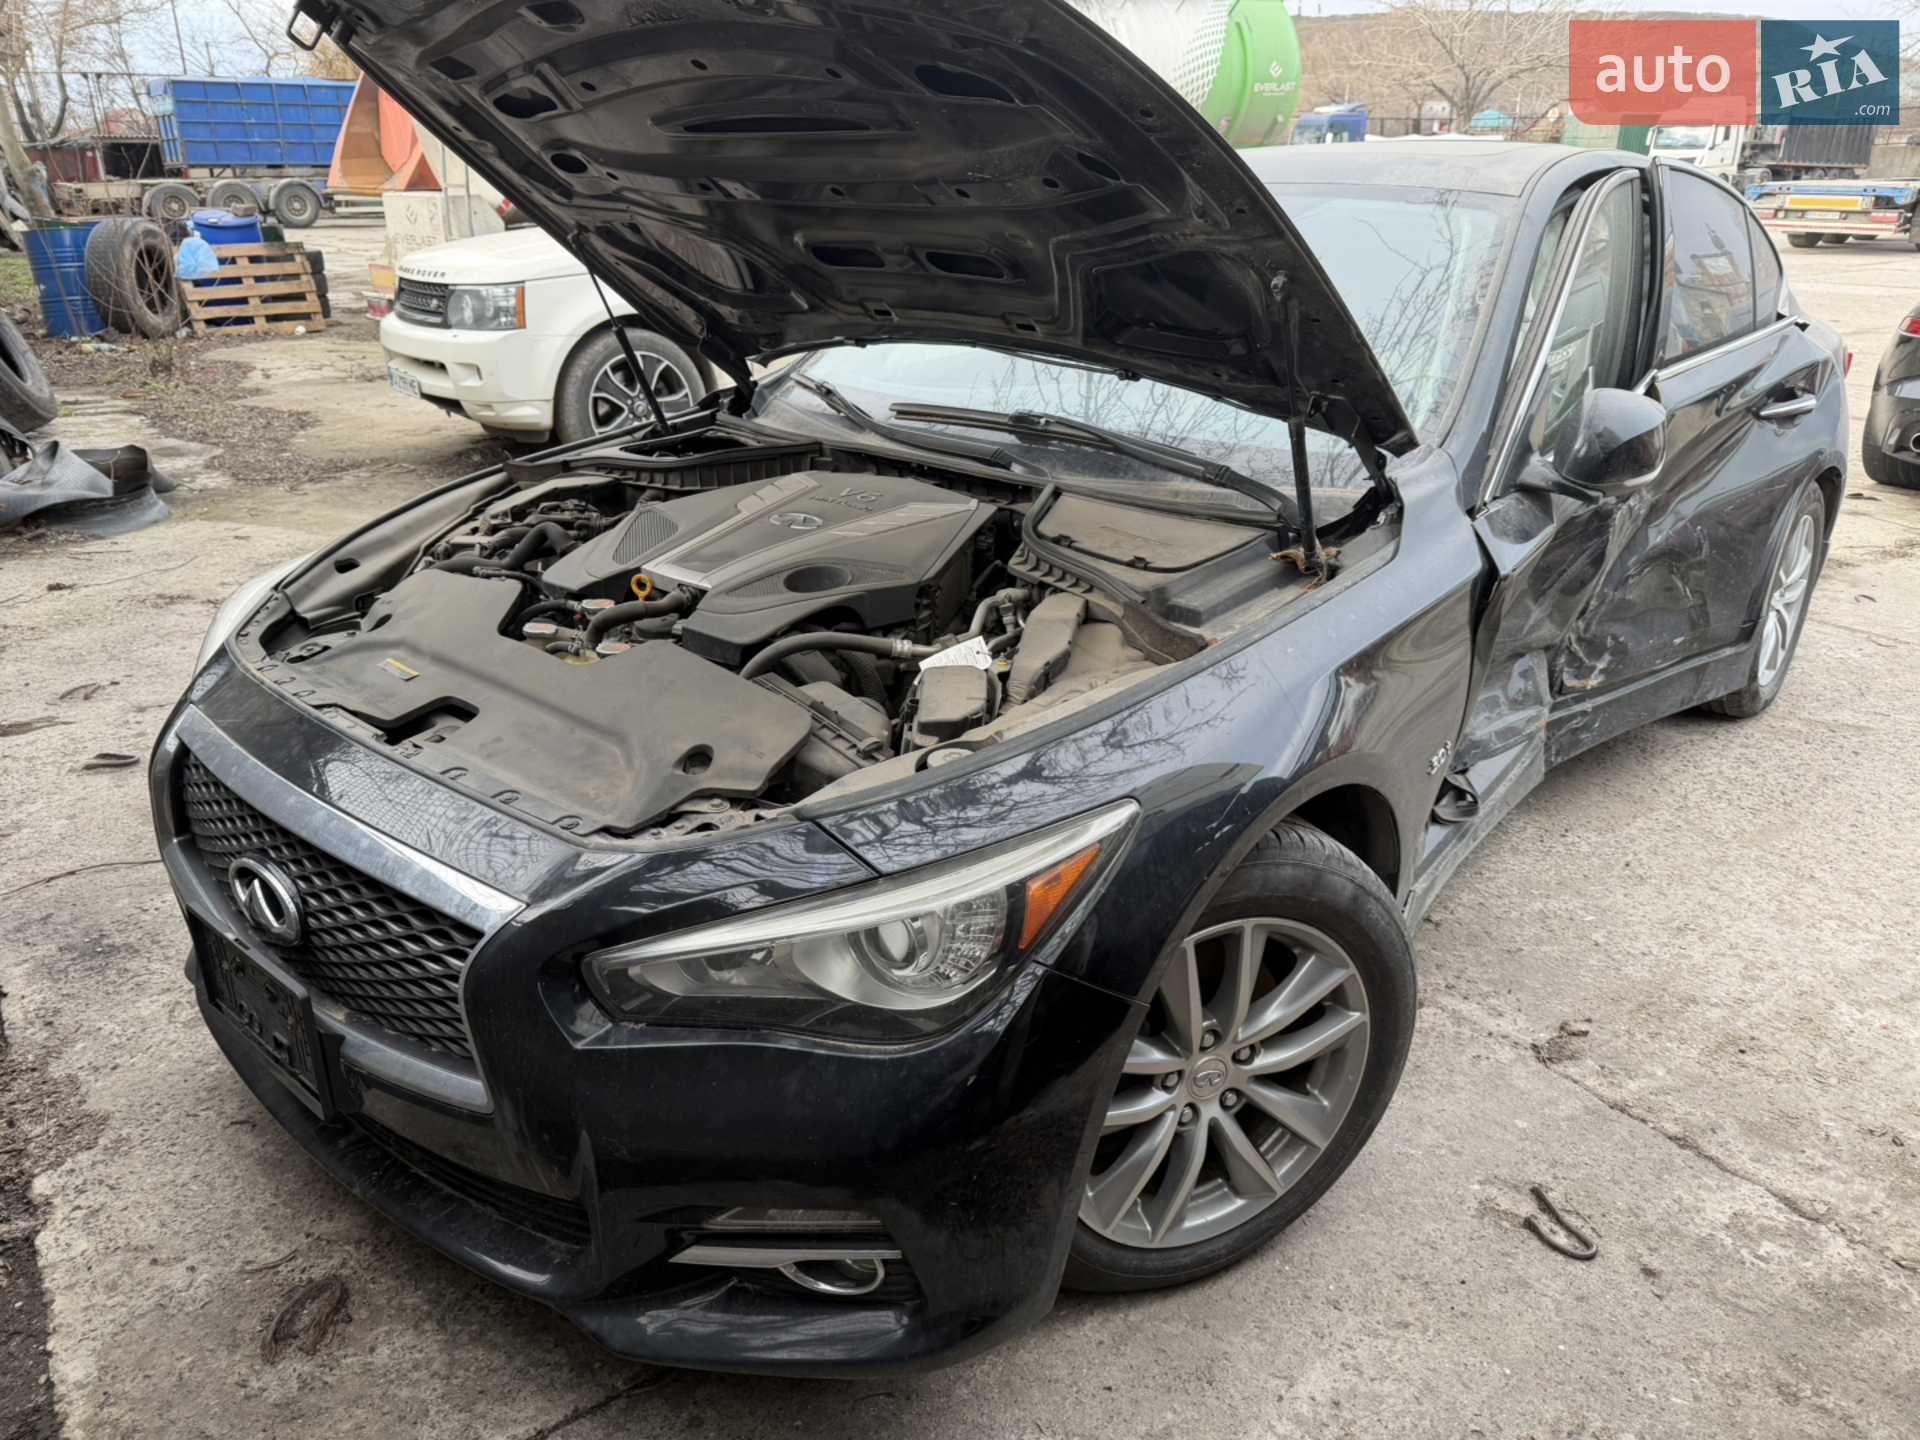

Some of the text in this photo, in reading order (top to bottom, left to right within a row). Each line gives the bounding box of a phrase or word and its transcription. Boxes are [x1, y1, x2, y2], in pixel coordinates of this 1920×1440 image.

[1253, 82, 1297, 93] EVERLAST
[416, 269, 447, 279] ROVER
[839, 487, 884, 503] V6
